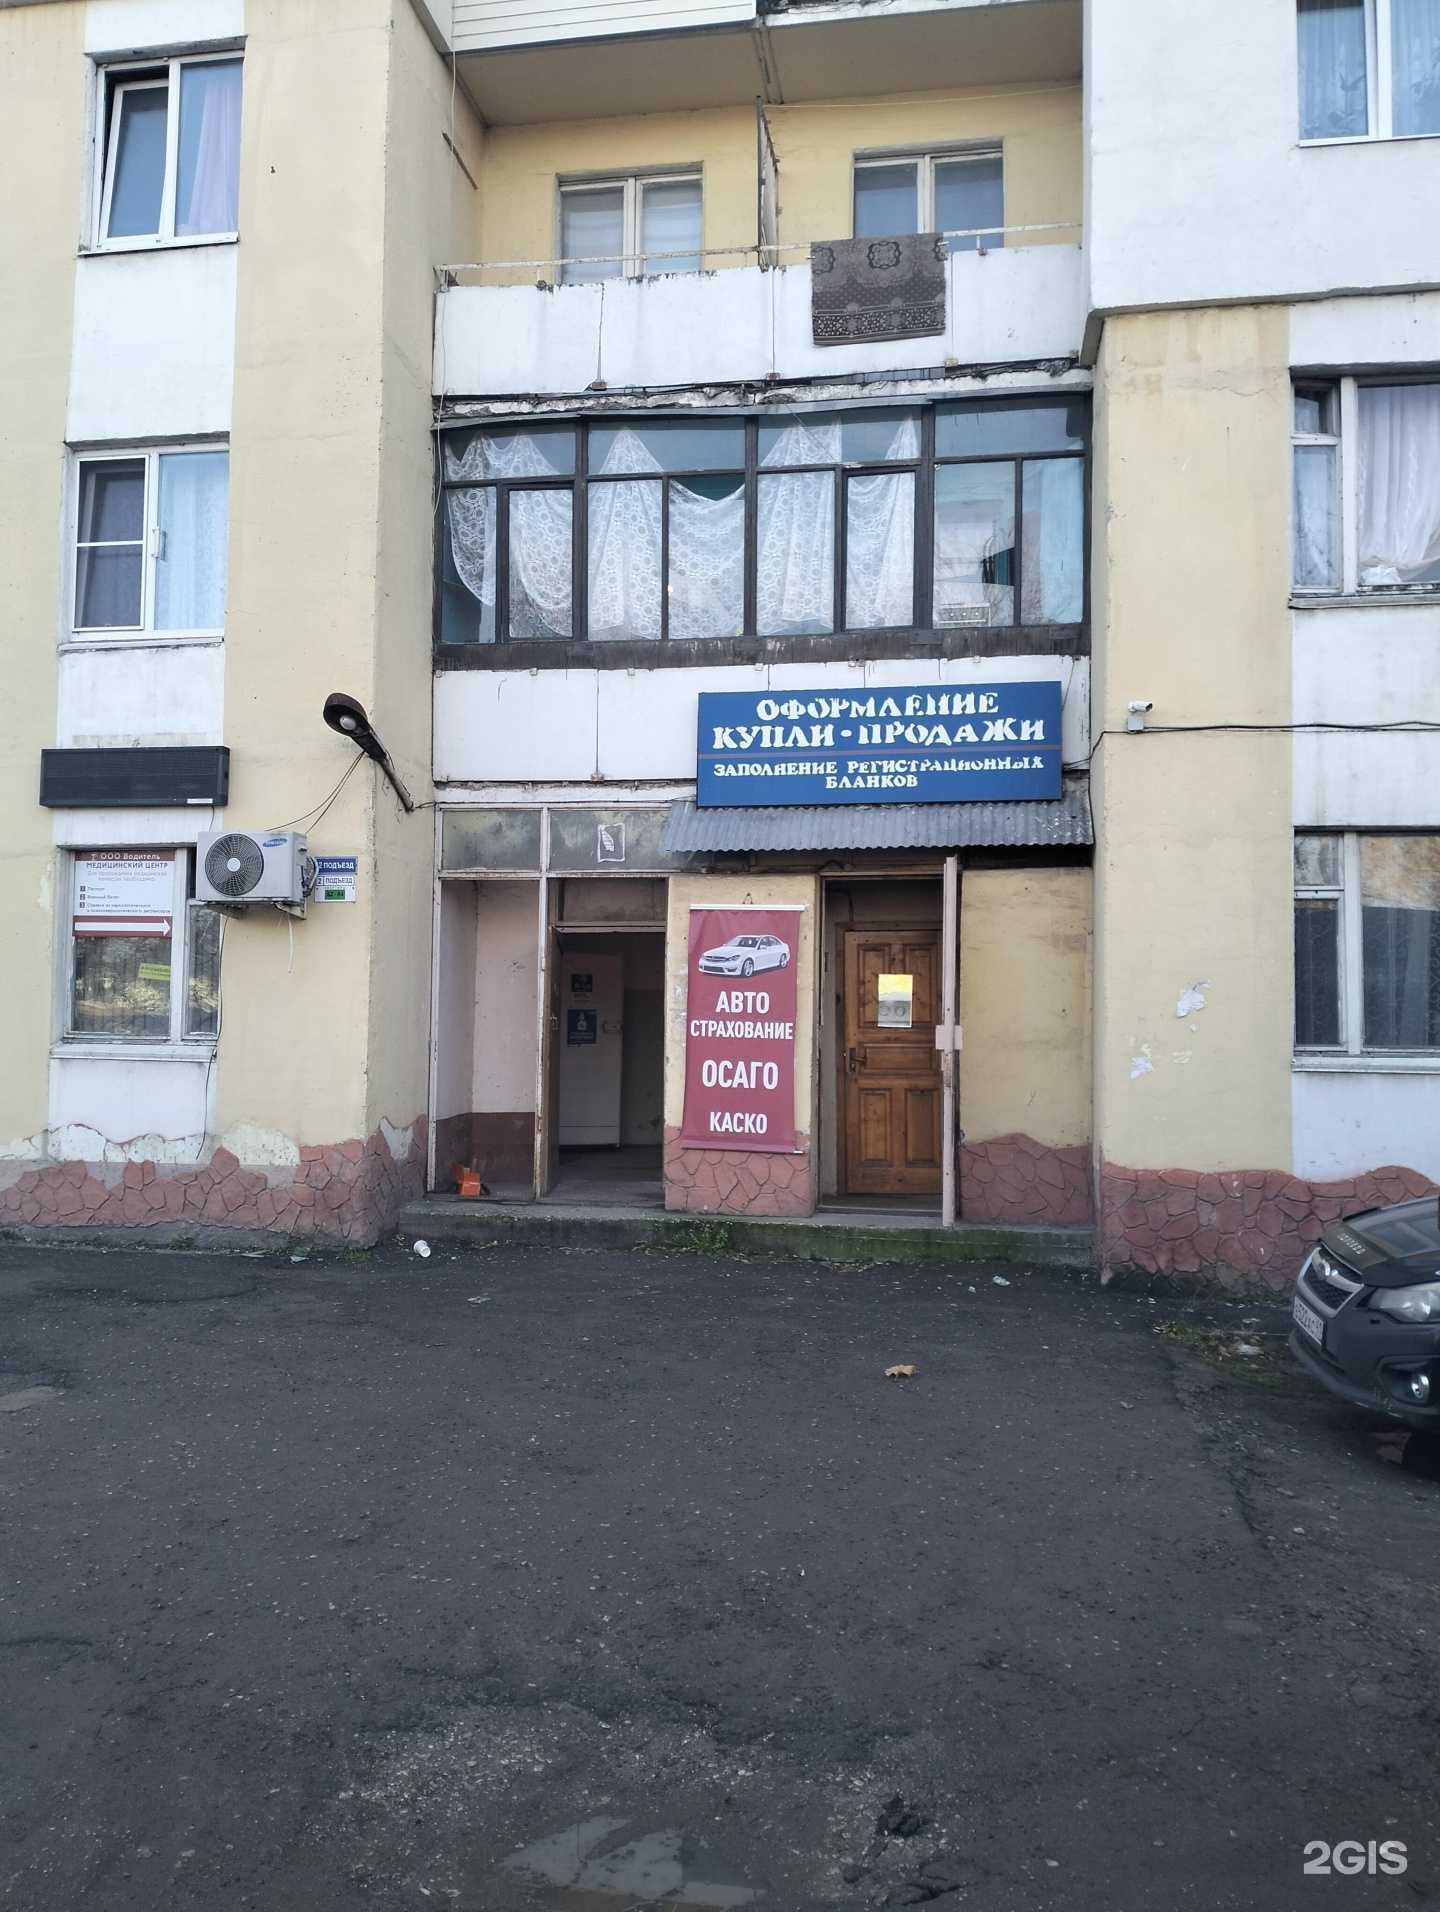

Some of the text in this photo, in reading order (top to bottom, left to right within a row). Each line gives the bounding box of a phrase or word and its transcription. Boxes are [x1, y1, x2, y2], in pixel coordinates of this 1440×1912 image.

[756, 692, 999, 721] ОФОРМЛЕНИЕ
[713, 756, 1045, 777] ЗАПОЛНЕНИЕ РЕГИСТРАЦИОННЫХ
[825, 774, 919, 789] БЛАНКОВ
[86, 861, 169, 869] МЕДИЦИНСКИЙ ЦЕНТР
[100, 852, 161, 861] ООО Водитель
[324, 861, 354, 870] ПОДЪЕЗД
[325, 877, 353, 885] ПОДЪЕЗД
[715, 991, 770, 1014] АВТО
[690, 1019, 793, 1040] СТРАХОВАНИЕ
[702, 1059, 779, 1090] ОСАГО
[709, 1111, 768, 1134] КАСКО
